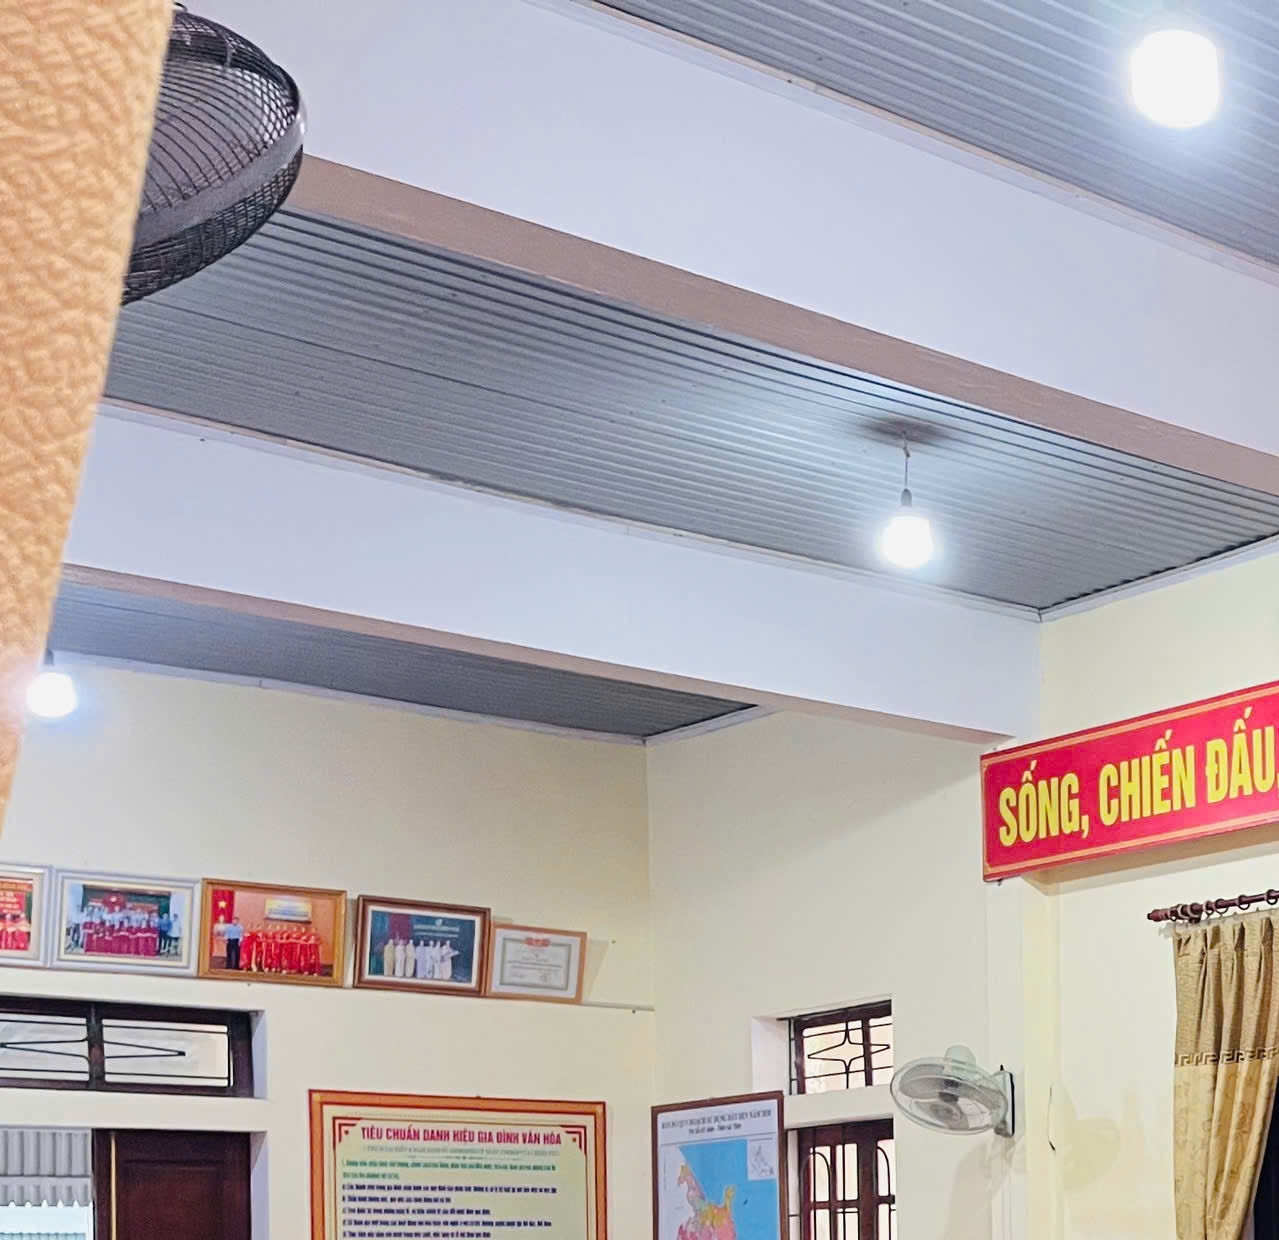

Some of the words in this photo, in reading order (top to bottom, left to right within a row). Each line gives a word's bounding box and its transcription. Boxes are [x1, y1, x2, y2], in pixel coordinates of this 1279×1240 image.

[998, 760, 1089, 847] SỐNG,
[1100, 728, 1196, 827] CHIẾN
[423, 1129, 450, 1141] DANH
[478, 1131, 493, 1143] GIA
